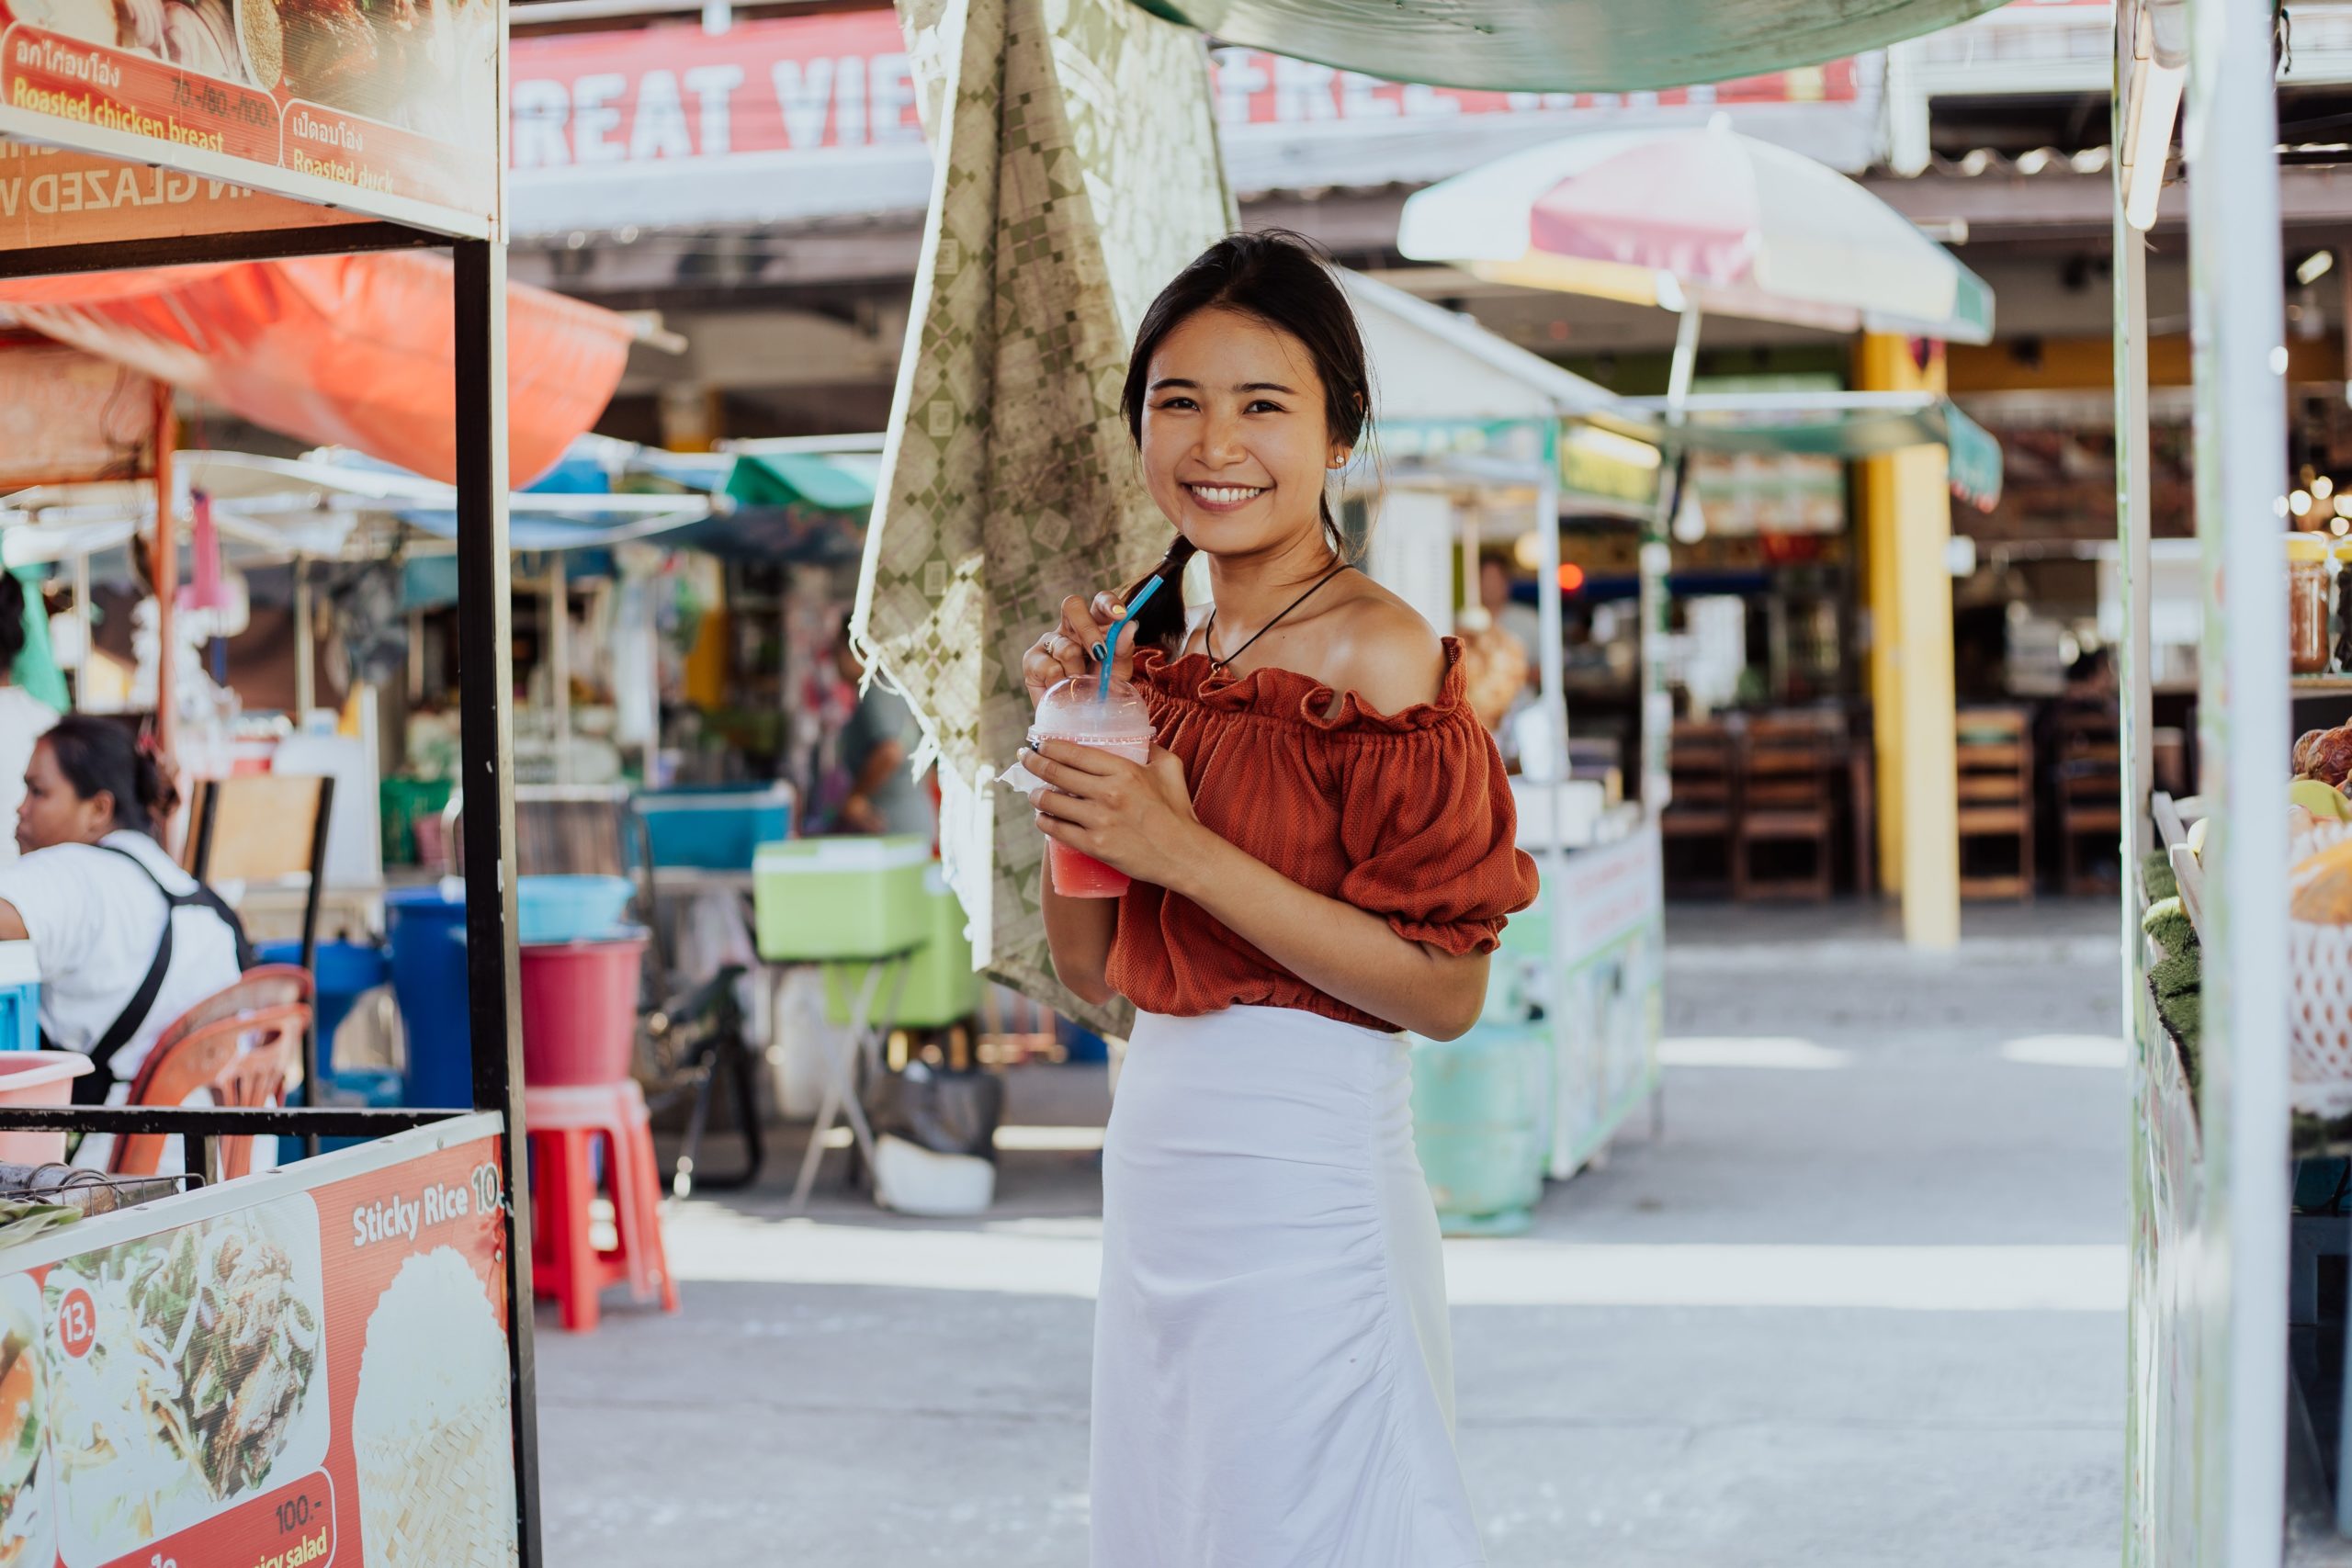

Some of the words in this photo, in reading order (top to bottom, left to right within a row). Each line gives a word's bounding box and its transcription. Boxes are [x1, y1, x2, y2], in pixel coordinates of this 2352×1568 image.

[13, 76, 90, 121] Roasted
[94, 96, 164, 140] chicken
[168, 115, 224, 153] breast
[292, 110, 364, 152] เป็ดอบโอ่ง
[294, 148, 356, 185] Roasted
[357, 164, 394, 195] duck
[353, 1193, 420, 1247] Sticky
[424, 1182, 469, 1226] Rice
[61, 1301, 94, 1343] 13.
[276, 1495, 322, 1535] 100.-
[286, 1525, 328, 1568] salad
